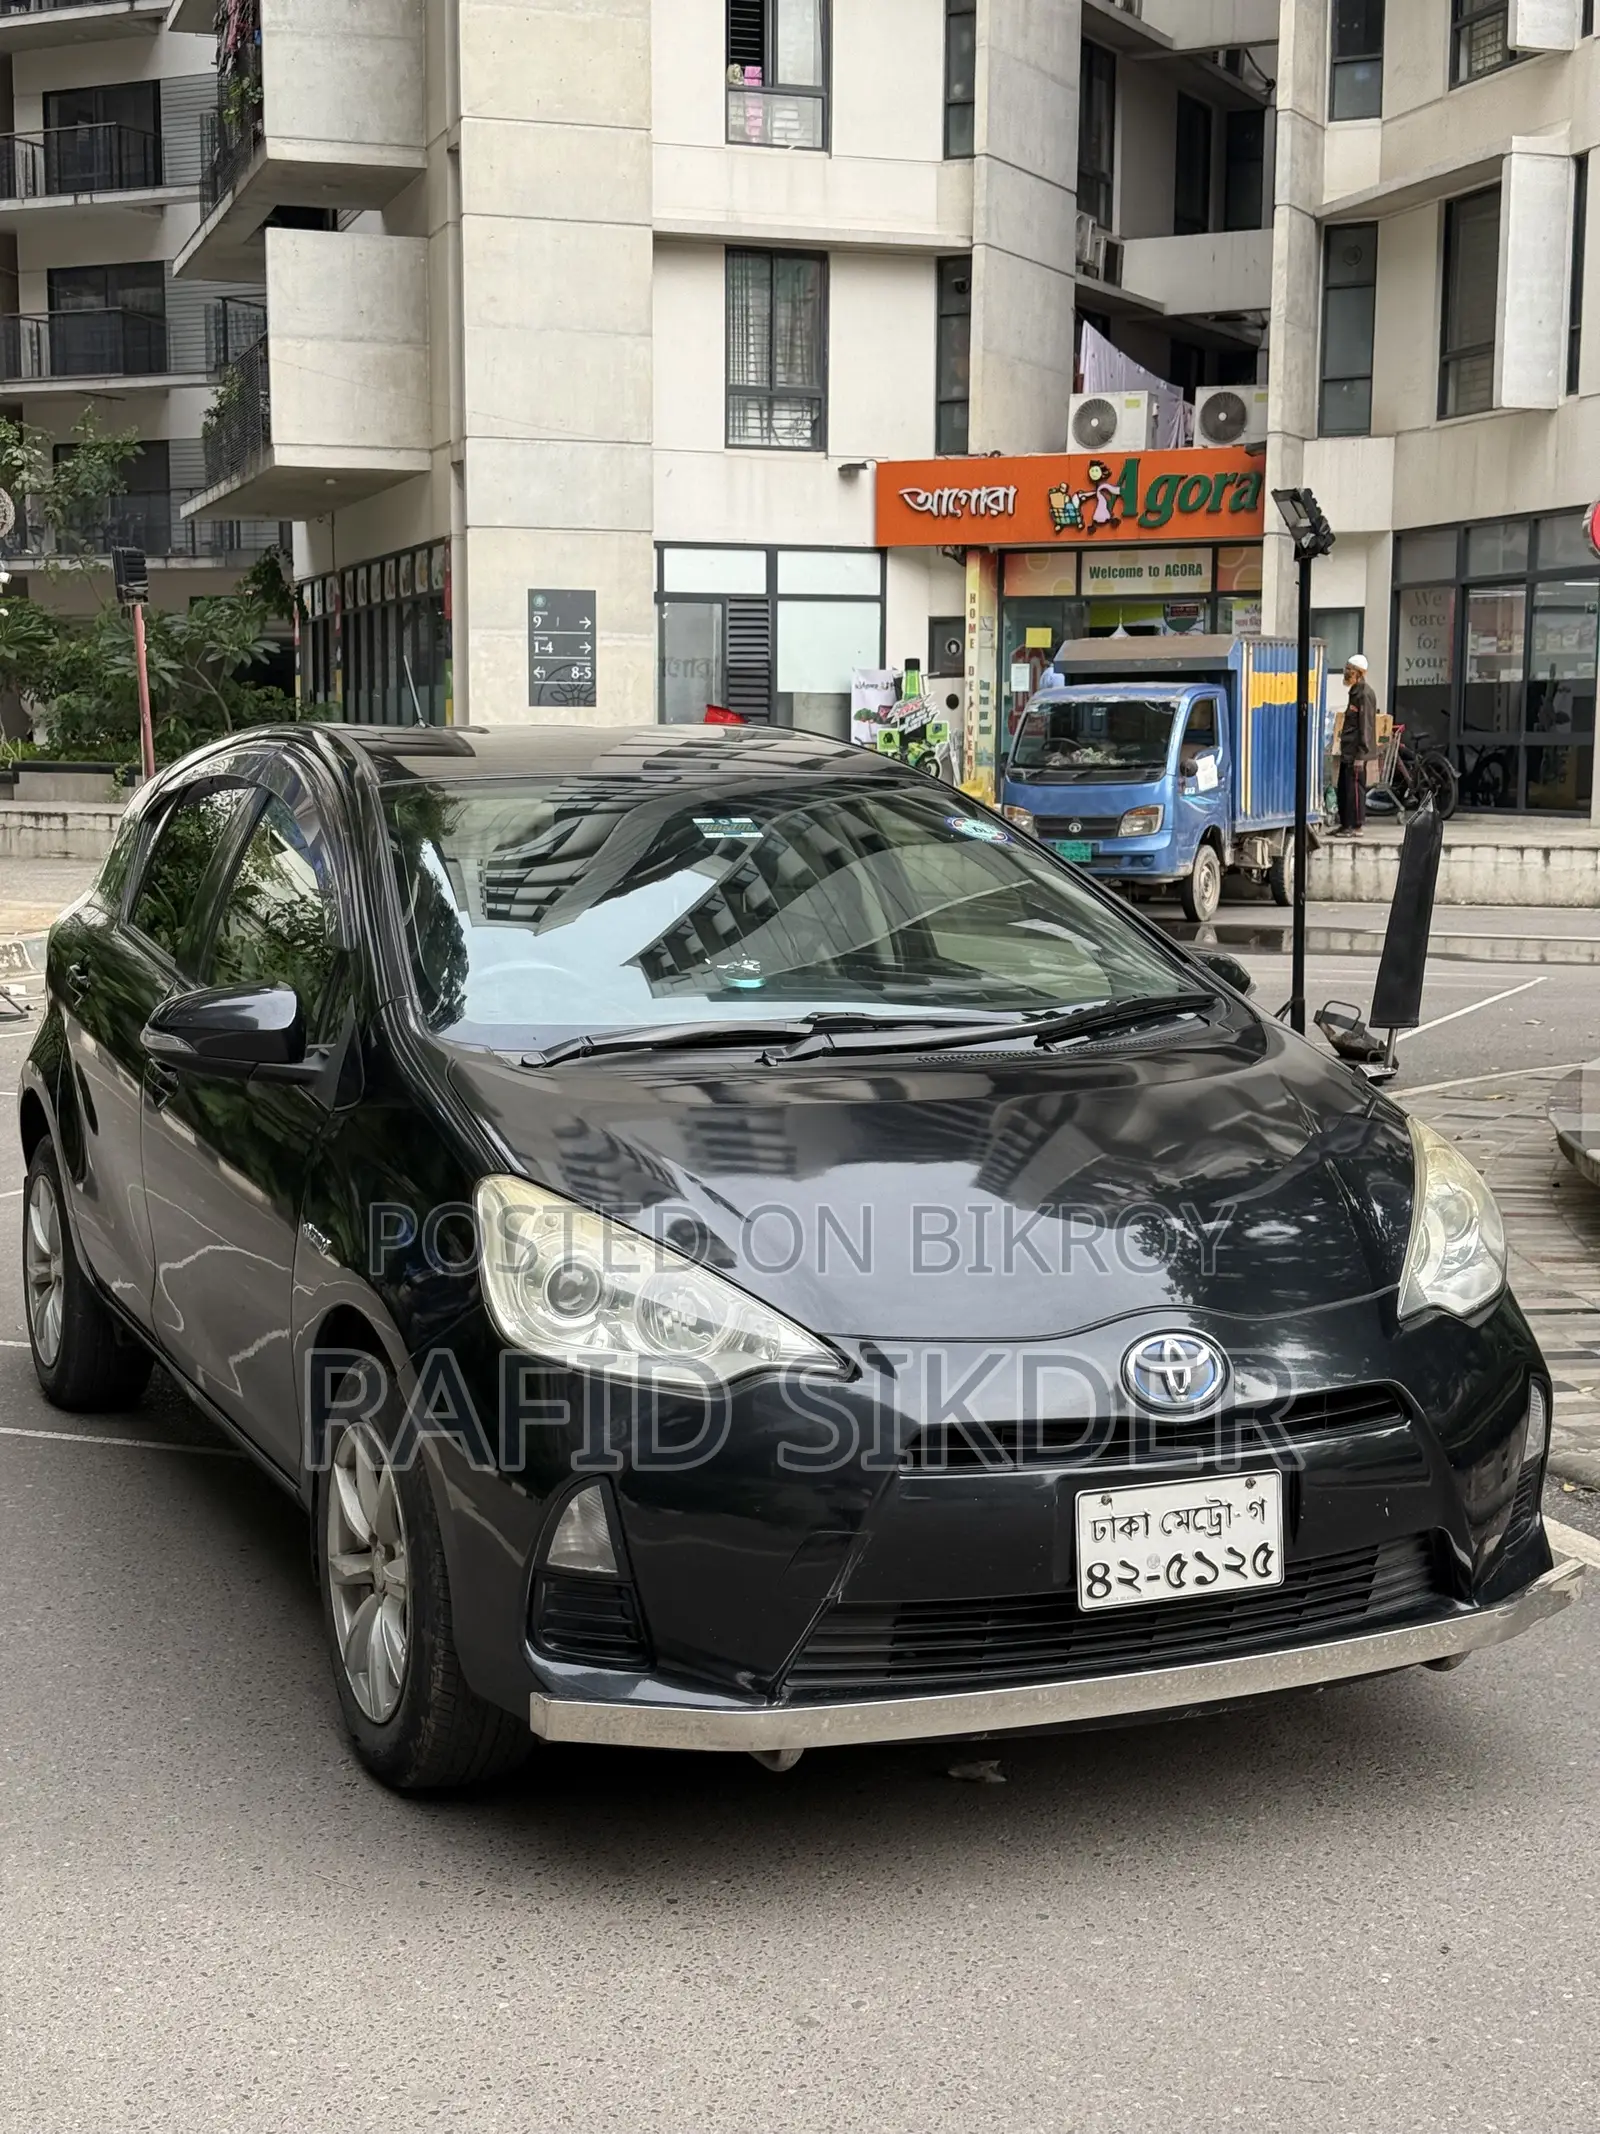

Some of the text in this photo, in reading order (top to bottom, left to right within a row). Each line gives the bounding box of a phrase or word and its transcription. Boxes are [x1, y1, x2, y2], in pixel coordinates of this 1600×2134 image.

[899, 485, 1018, 517] আগোরা
[1107, 457, 1263, 528] Agora
[1089, 563, 1203, 579] Welcome to AGORA
[1414, 590, 1442, 607] We
[532, 615, 542, 628] 9
[968, 592, 977, 649] HOME
[1409, 613, 1446, 627] care
[533, 641, 554, 653] 1-4
[1417, 632, 1440, 649] for
[1404, 656, 1448, 671] your
[571, 666, 592, 679] 8-5
[1089, 1509, 1151, 1542] ঢাকা
[1086, 1541, 1275, 1600] ৪২-৫১২৫
